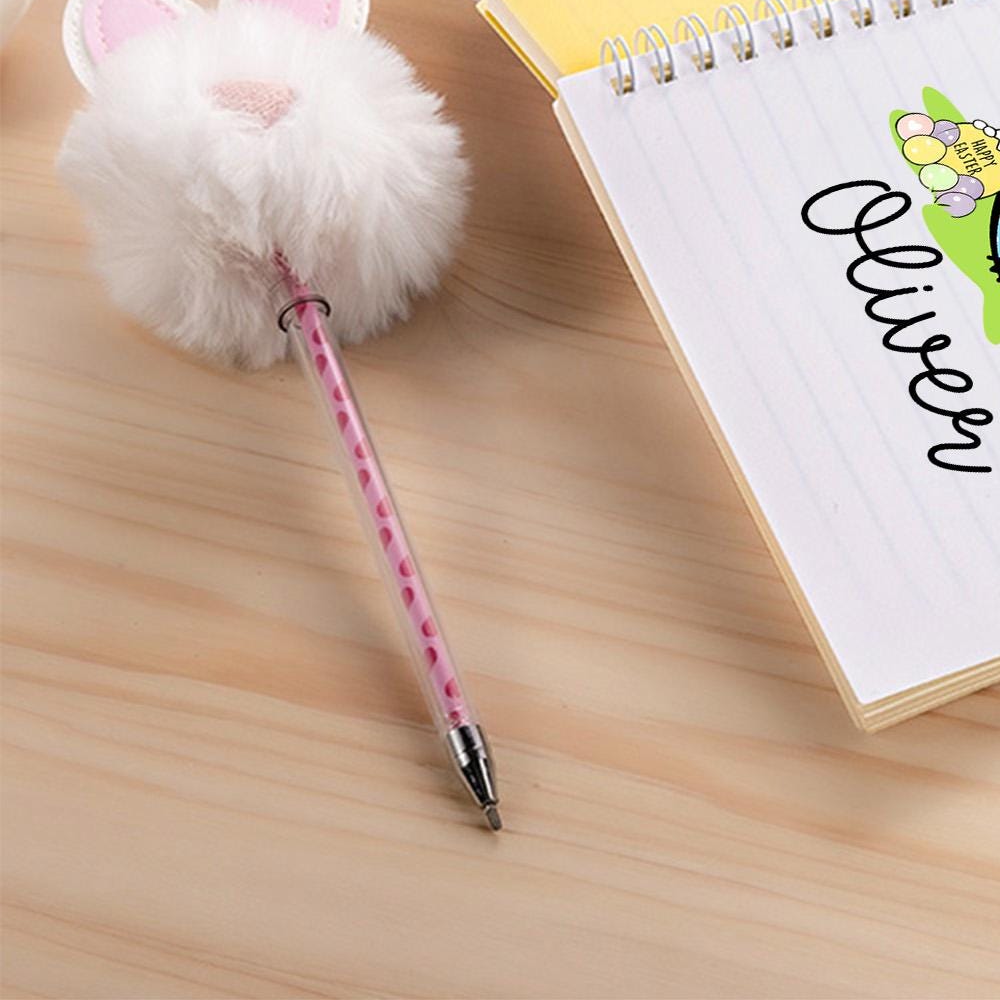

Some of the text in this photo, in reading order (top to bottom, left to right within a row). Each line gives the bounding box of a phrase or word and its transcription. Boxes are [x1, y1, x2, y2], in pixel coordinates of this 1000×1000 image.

[953, 141, 983, 177] EASTER
[971, 139, 998, 168] HAPPY
[800, 179, 994, 473] Oliver
